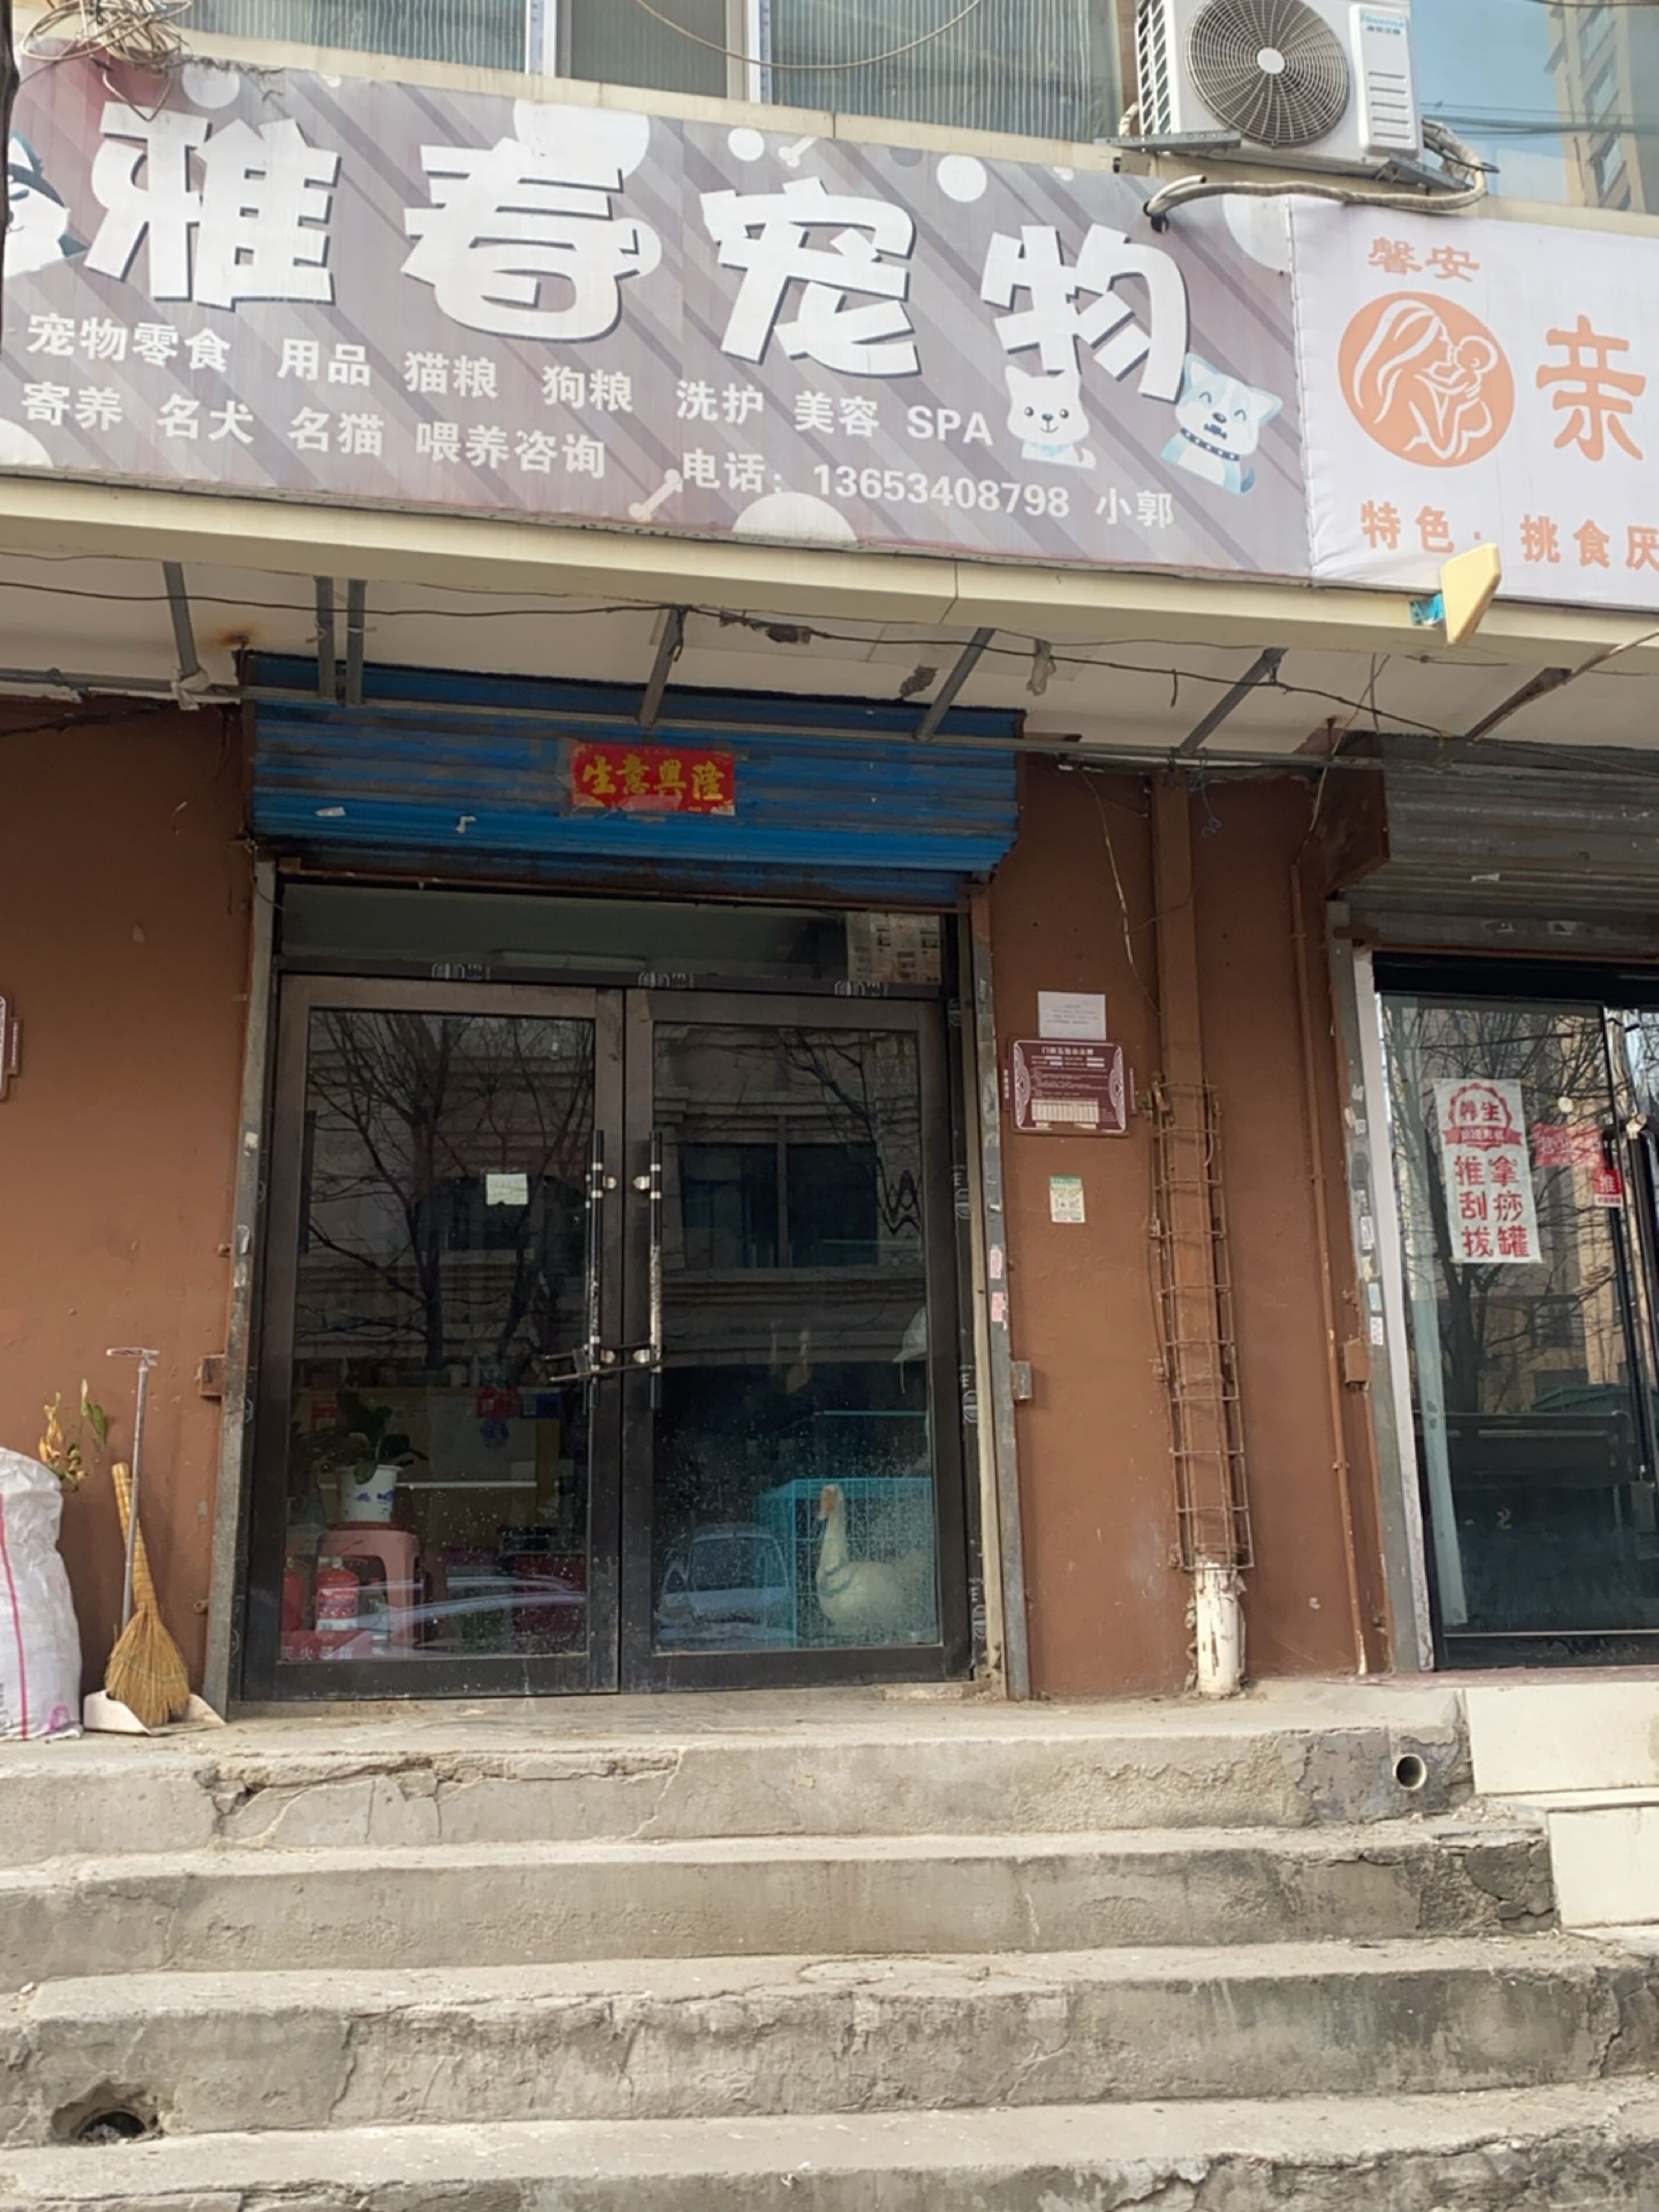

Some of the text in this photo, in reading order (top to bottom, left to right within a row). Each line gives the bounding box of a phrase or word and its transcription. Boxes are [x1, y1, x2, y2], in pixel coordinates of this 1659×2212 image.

[1368, 237, 1480, 282] 馨安
[27, 313, 994, 446] 宠物零食 用品 猫粮 狗粮 洗护 美容 SPA
[1537, 314, 1646, 461] 亲
[22, 382, 123, 431] 寄养
[157, 393, 253, 444] 名犬
[287, 406, 383, 457] 名猫
[416, 421, 605, 479] 喂养咨询
[813, 465, 1070, 517] 13653408798
[1096, 488, 1174, 528] 小郭
[1454, 1155, 1520, 1187] 推拿
[1459, 1190, 1523, 1222] 刮痧
[1461, 1225, 1530, 1257] 拔罐
